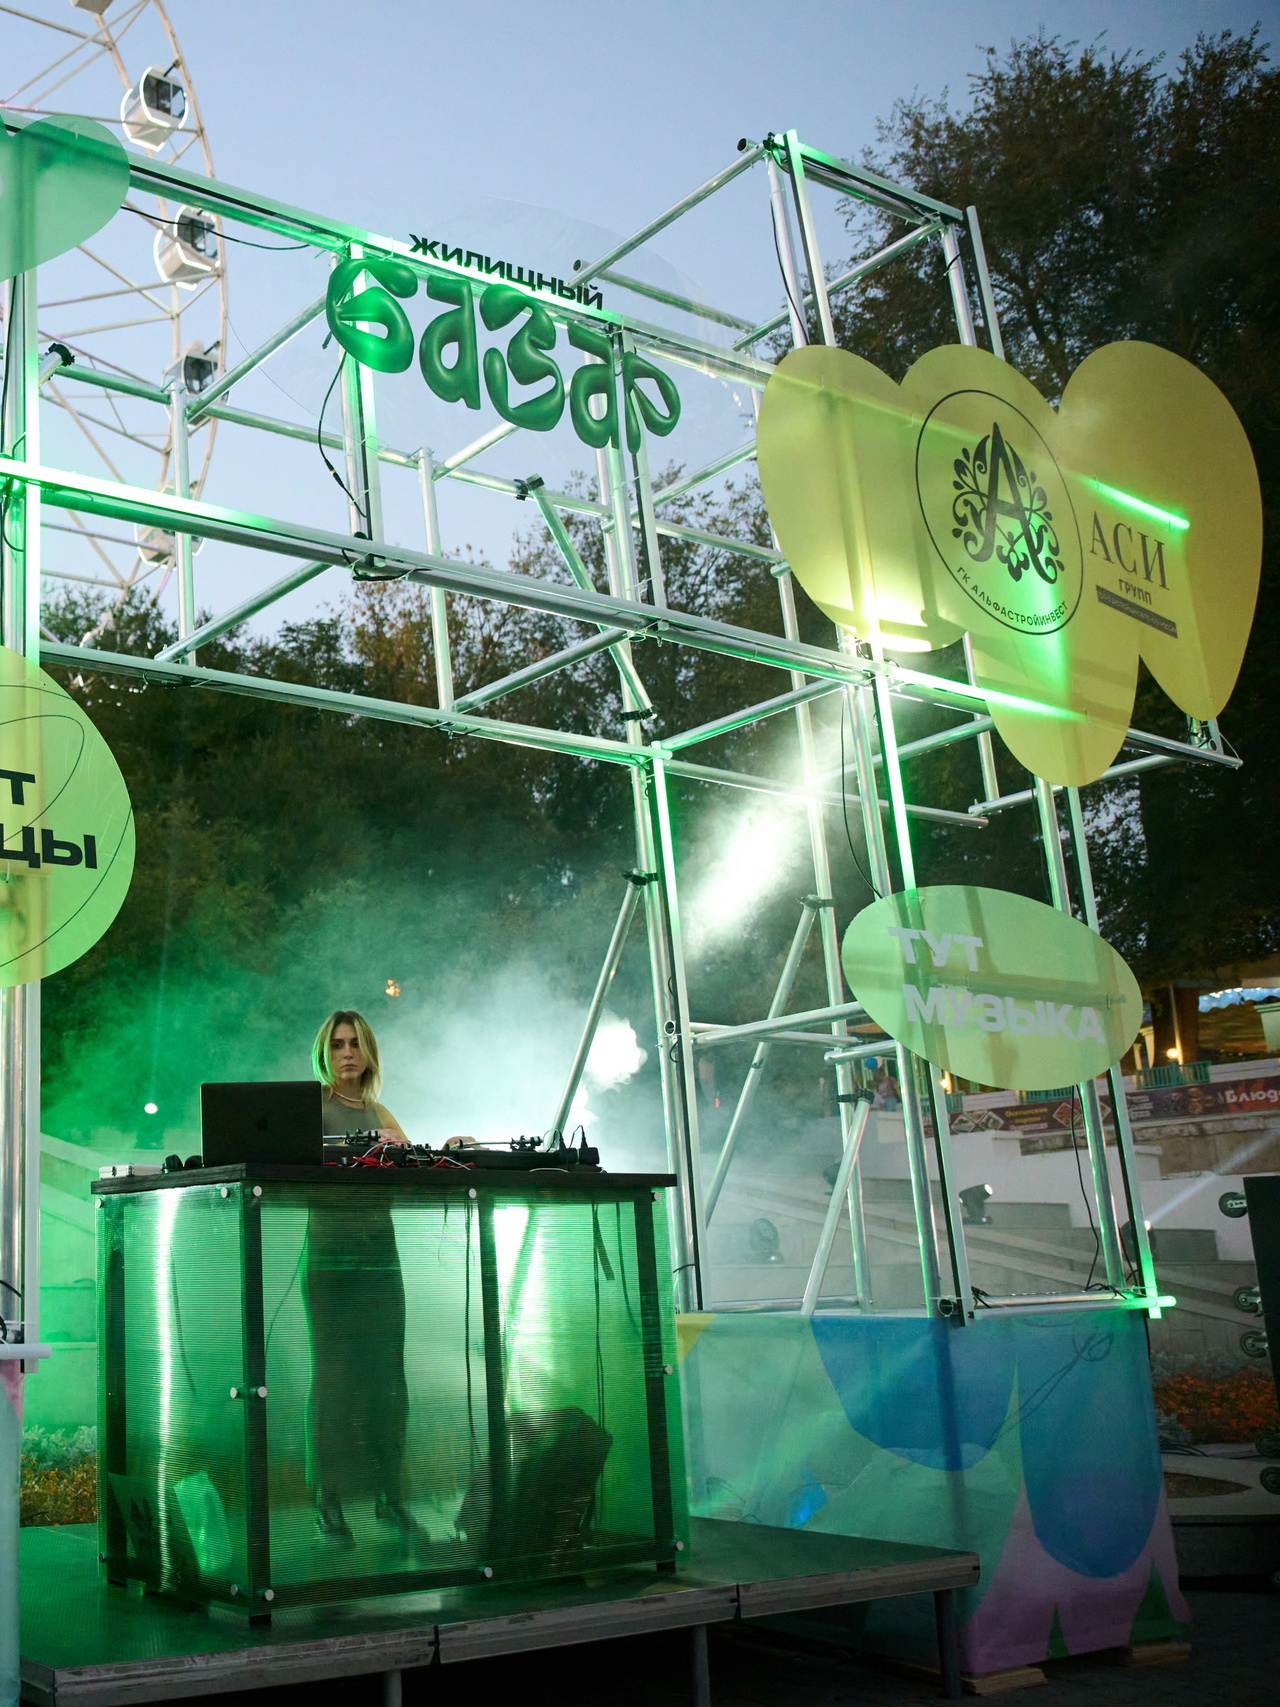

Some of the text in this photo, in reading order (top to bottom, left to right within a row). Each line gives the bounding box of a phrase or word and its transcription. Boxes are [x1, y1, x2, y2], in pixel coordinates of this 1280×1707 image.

[1090, 510, 1170, 591] АСИ
[957, 566, 971, 584] ГК
[971, 584, 1068, 627] АЛЬФАСТРОЙИНВЕСТ
[1118, 578, 1152, 606] ГРУПП
[887, 926, 984, 973] ТУТ
[901, 984, 1107, 1045] МУЗЫКА
[1225, 1089, 1280, 1104] Блюд
